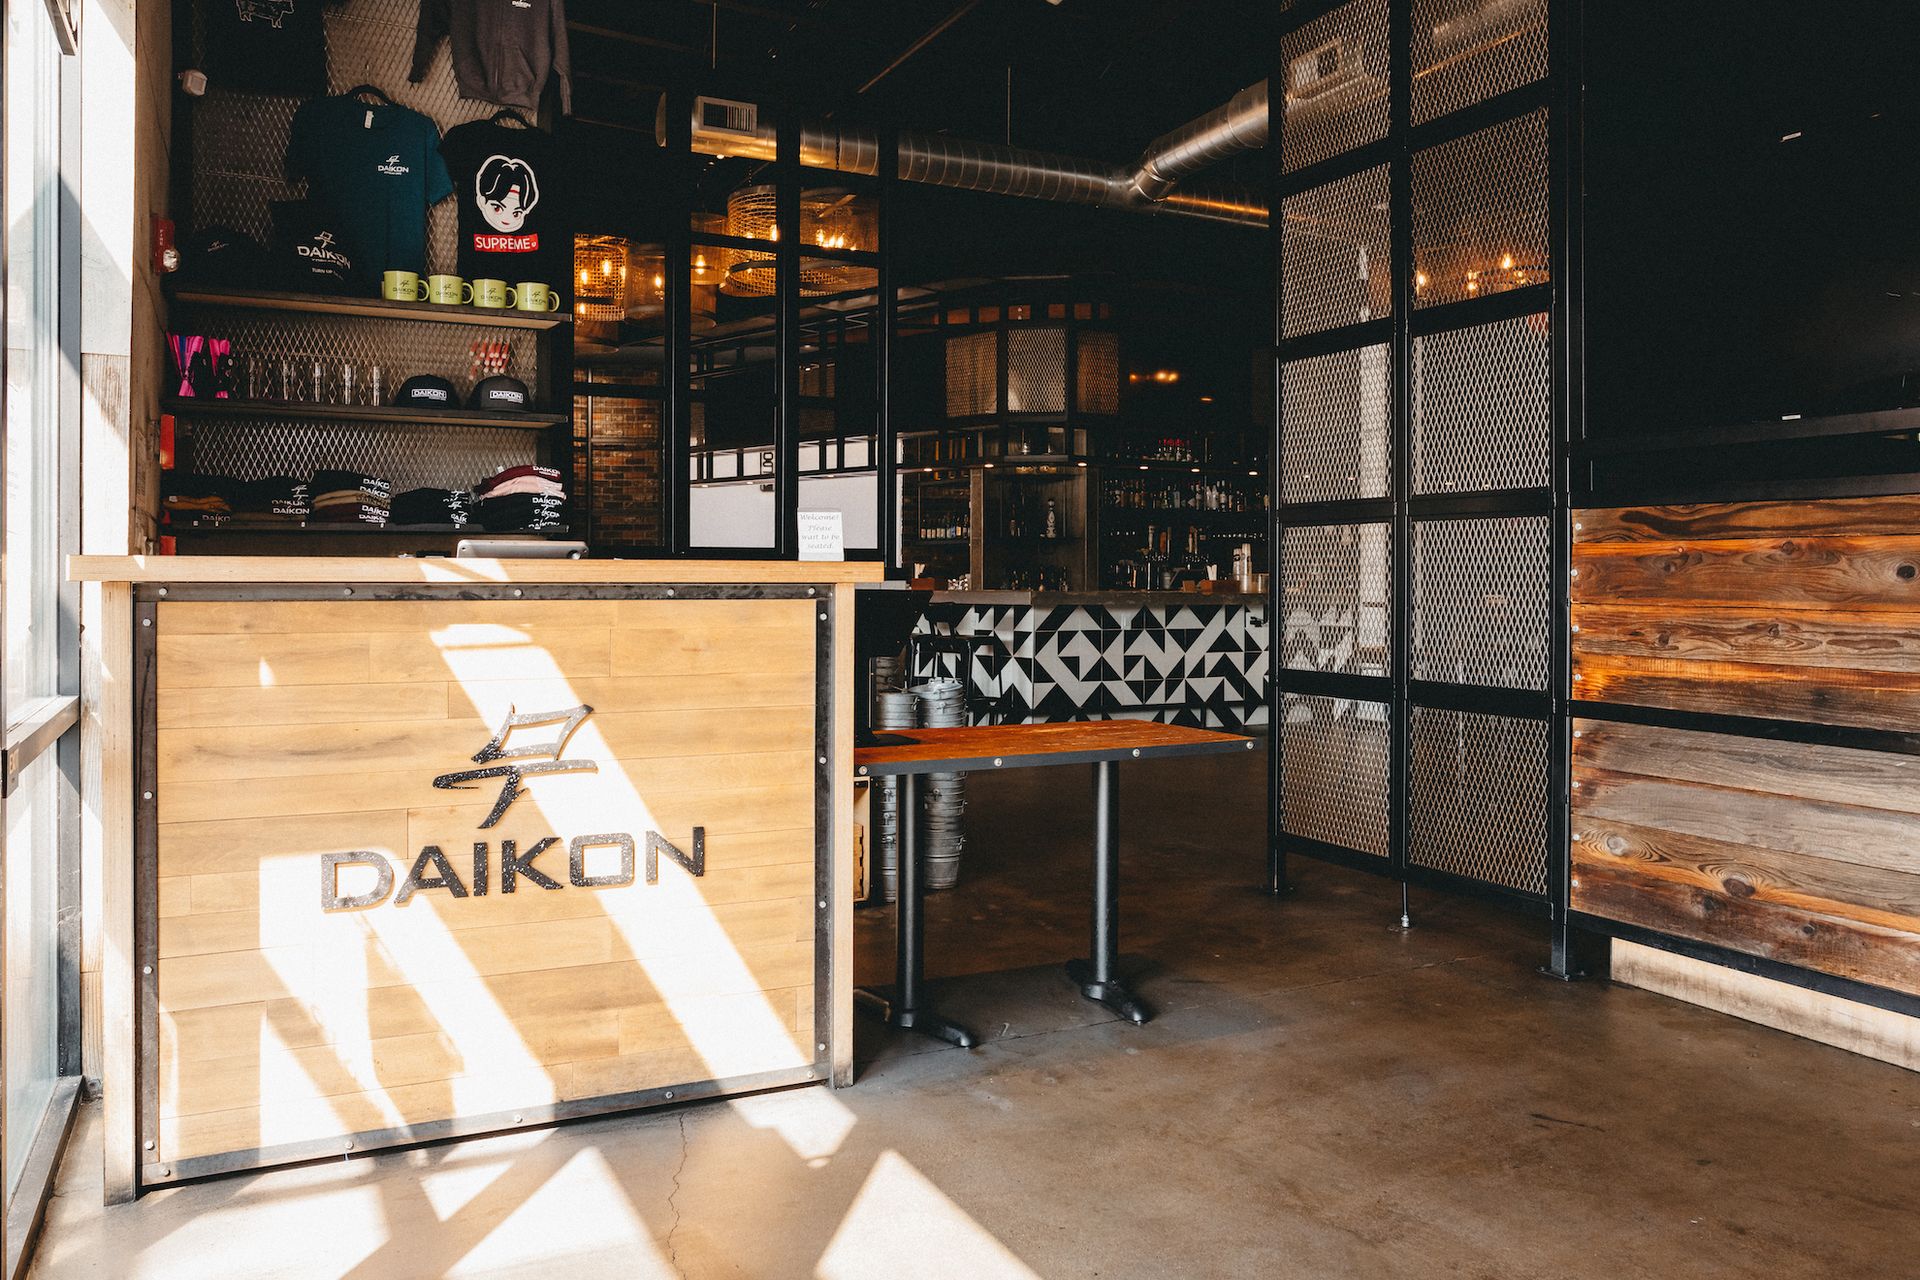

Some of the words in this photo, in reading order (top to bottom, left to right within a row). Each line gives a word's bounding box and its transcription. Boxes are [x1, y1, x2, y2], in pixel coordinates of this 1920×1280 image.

[377, 165, 409, 173] DAIKON
[475, 236, 531, 250] SUPREME
[297, 246, 351, 270] DAIKON
[413, 389, 445, 398] DAIKON
[491, 390, 522, 400] DAIKON
[272, 506, 310, 515] DAIKON
[320, 826, 707, 913] DAIKON
